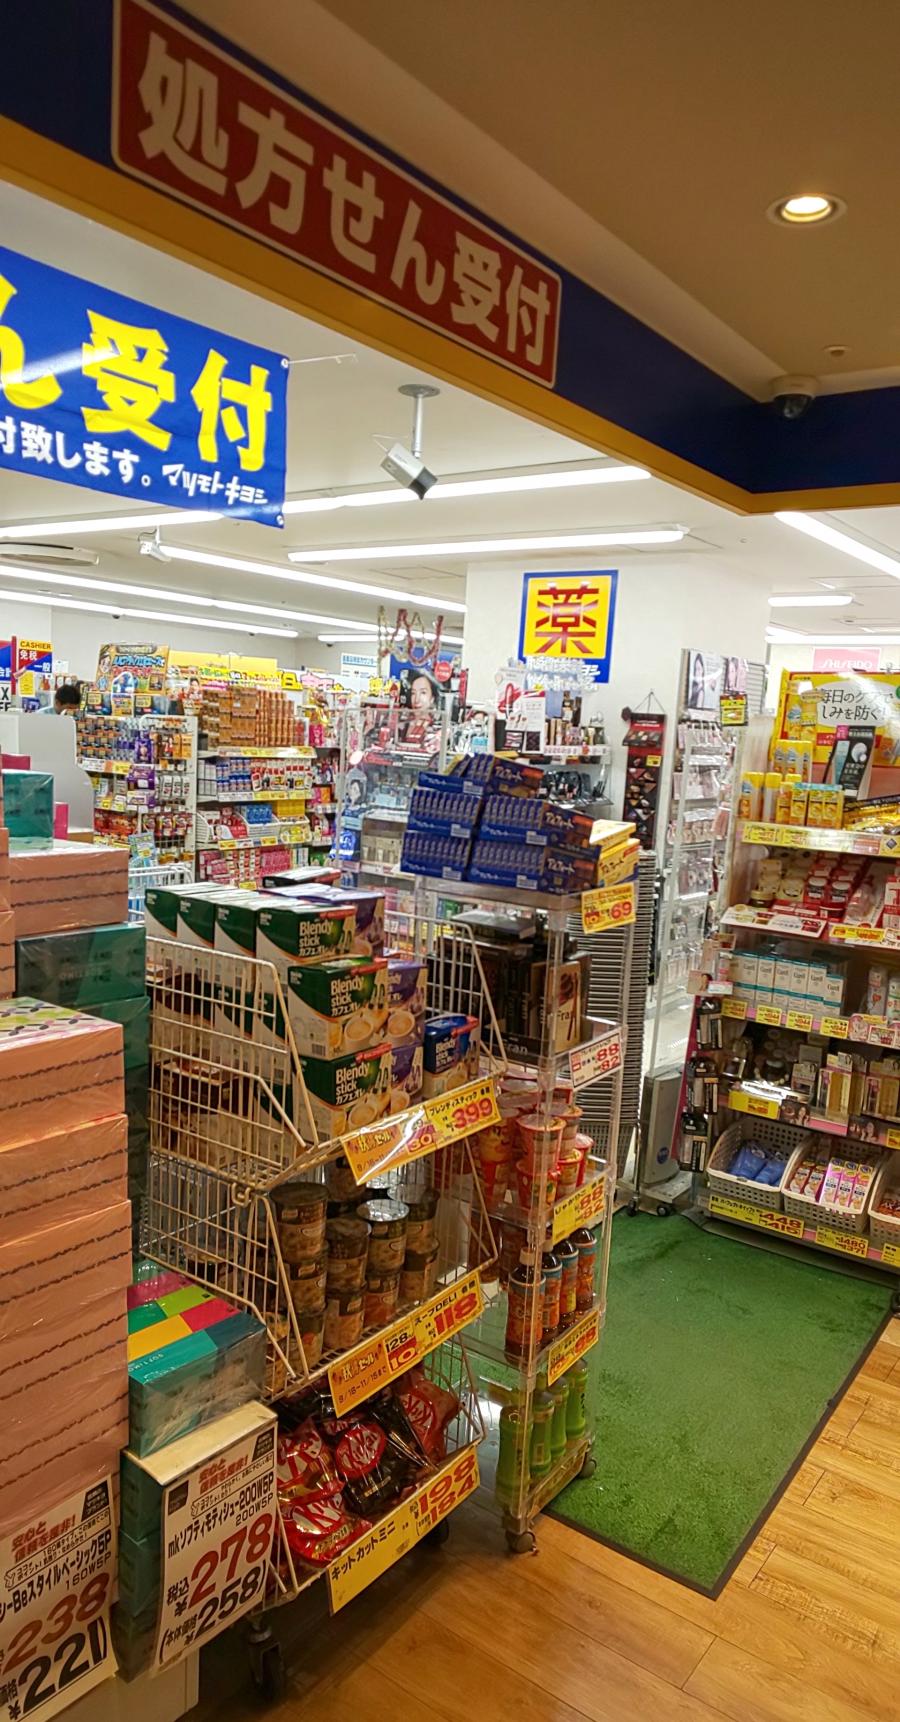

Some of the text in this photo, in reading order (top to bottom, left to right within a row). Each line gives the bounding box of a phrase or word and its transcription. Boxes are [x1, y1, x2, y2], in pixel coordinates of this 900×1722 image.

[137, 31, 550, 367] 処方せん受付
[162, 463, 268, 504] マツモトキヨシ
[535, 583, 599, 654] 薬
[20, 640, 51, 650] CASHIER
[20, 649, 37, 660] 免税
[820, 660, 873, 669] SHISEIDO
[611, 901, 632, 919] 69
[300, 921, 334, 936] Blendy
[300, 935, 320, 947] stick
[331, 975, 364, 995] Blendy
[331, 992, 352, 1007] stick
[336, 1062, 370, 1085] Blendy
[336, 1080, 357, 1096] stick
[451, 1097, 493, 1130] 399
[763, 1213, 801, 1229] 448
[414, 1293, 457, 1327] スープDELI
[433, 1292, 478, 1336] 118
[418, 1454, 476, 1517] 198
[236, 1492, 274, 1526] 200W5P
[331, 1520, 396, 1581] キットカットミニ
[66, 1551, 112, 1590] 160W5P
[2, 1572, 109, 1676] 238
